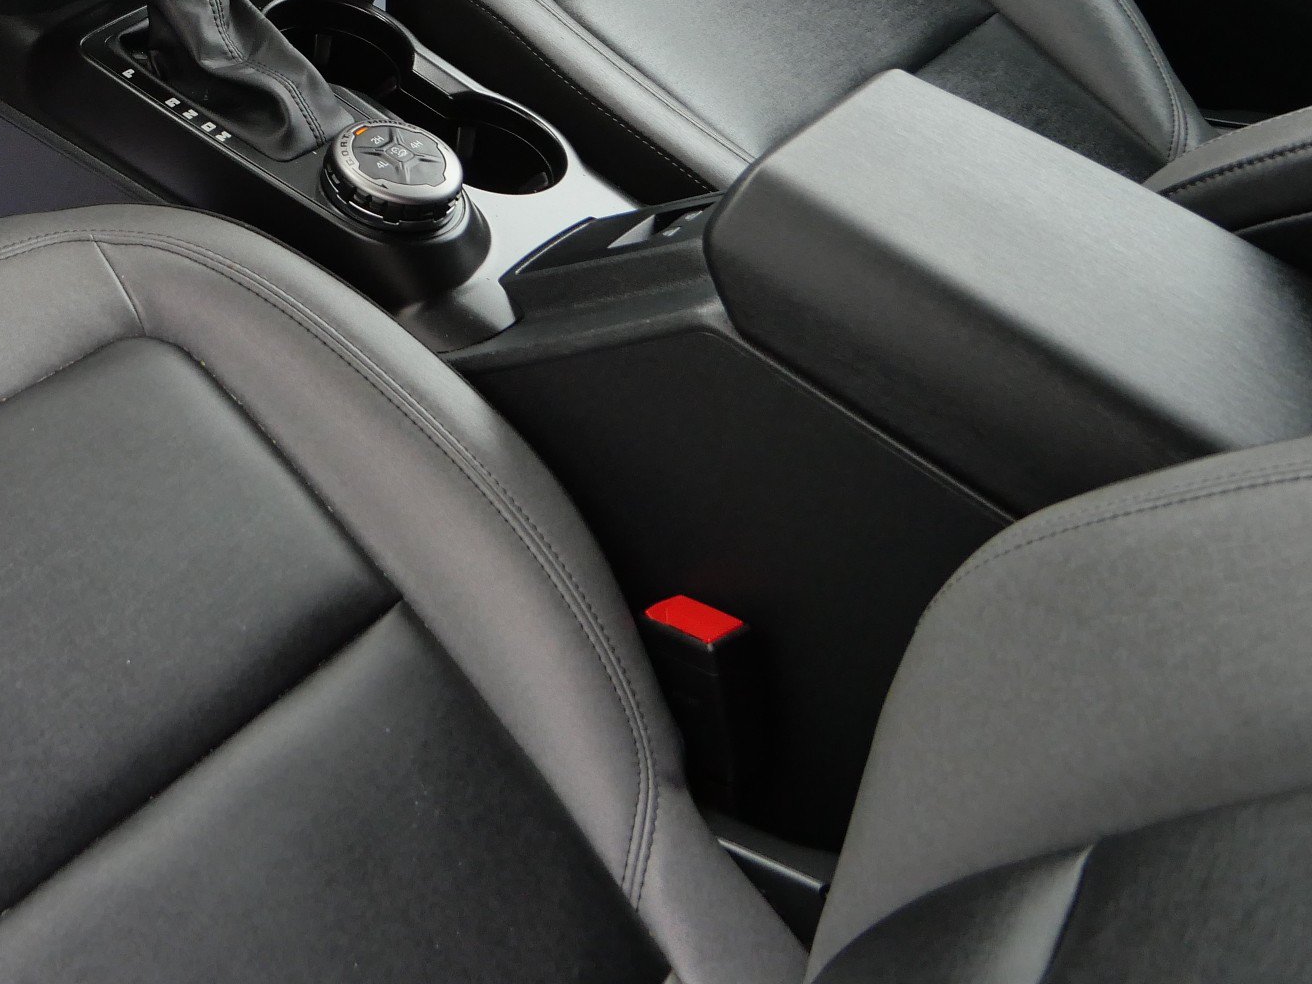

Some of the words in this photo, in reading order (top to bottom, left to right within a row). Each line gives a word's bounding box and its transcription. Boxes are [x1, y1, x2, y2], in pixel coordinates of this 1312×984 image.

[215, 130, 232, 143] M
[370, 134, 385, 146] 2H
[409, 139, 424, 150] 4H
[376, 160, 389, 170] 4L
